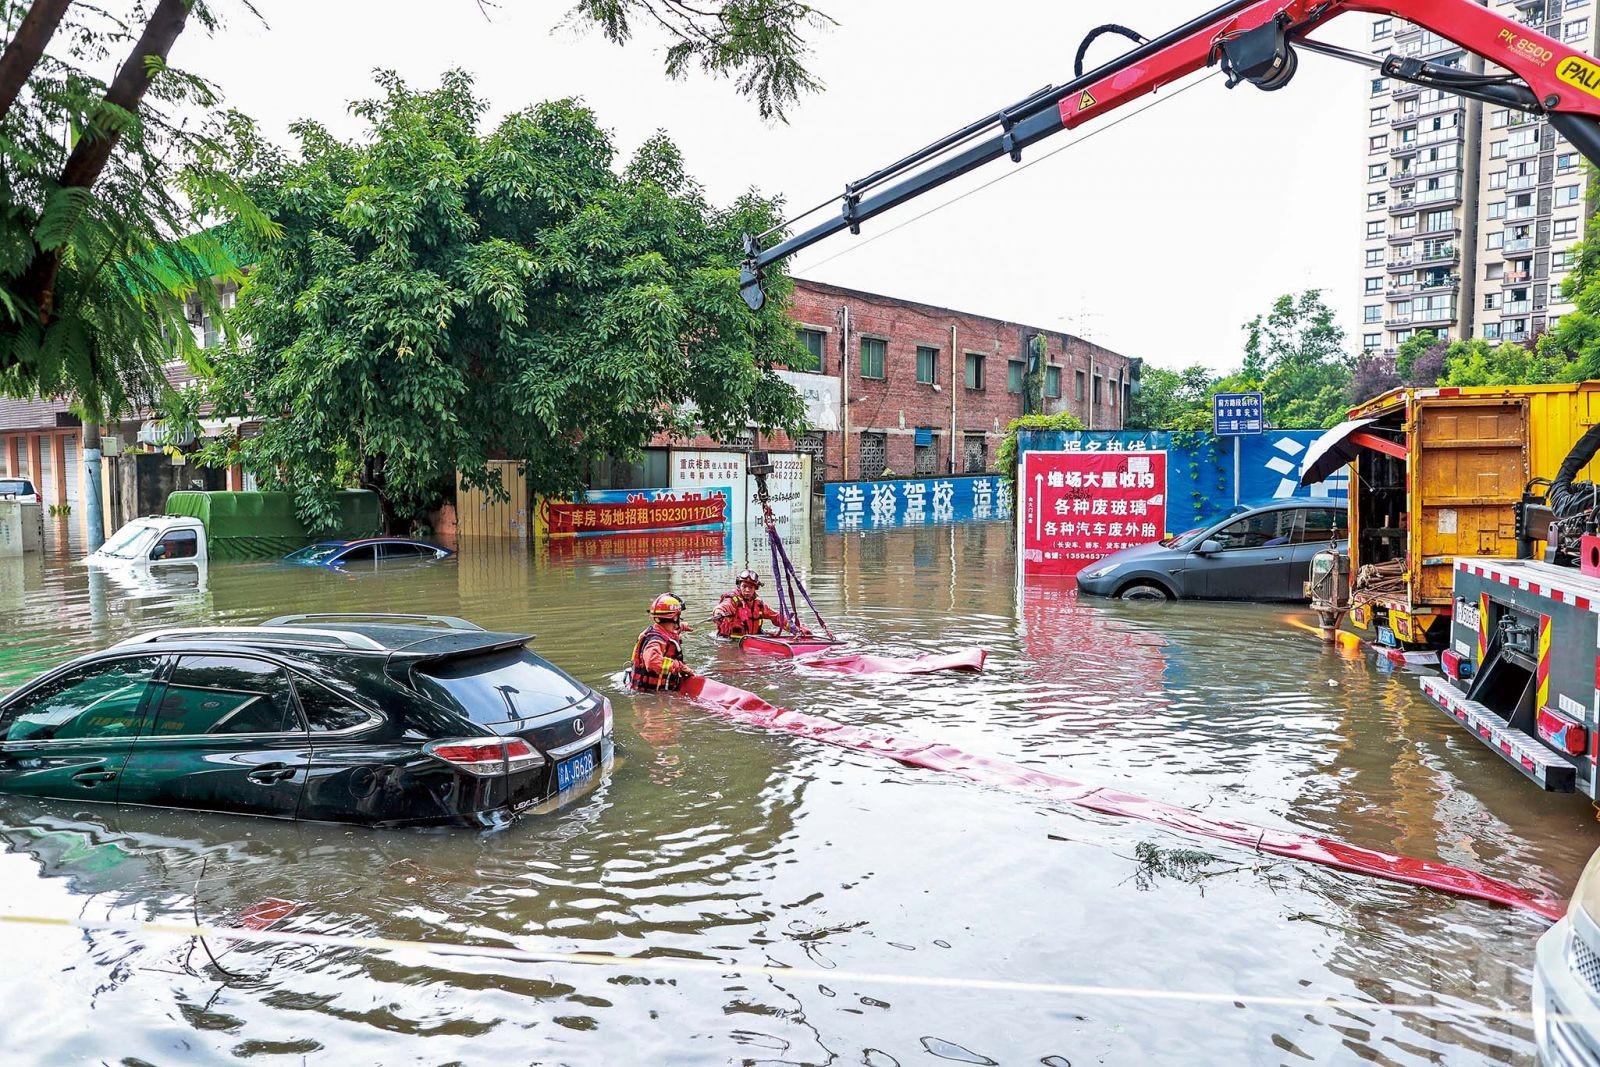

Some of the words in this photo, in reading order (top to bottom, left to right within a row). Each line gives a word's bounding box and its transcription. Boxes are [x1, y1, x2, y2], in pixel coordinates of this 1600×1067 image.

[1498, 28, 1518, 45] PK
[1517, 38, 1553, 62] 8500
[1507, 45, 1546, 68] Performance
[1218, 408, 1259, 417] 请注意安全
[1047, 471, 1155, 488] 堆场大量收购
[837, 481, 954, 512] 浩裕驾校
[1054, 498, 1148, 516] 各种废玻璃
[557, 509, 597, 527] 厂库房
[1044, 521, 1157, 537] 各种汽车废外胎
